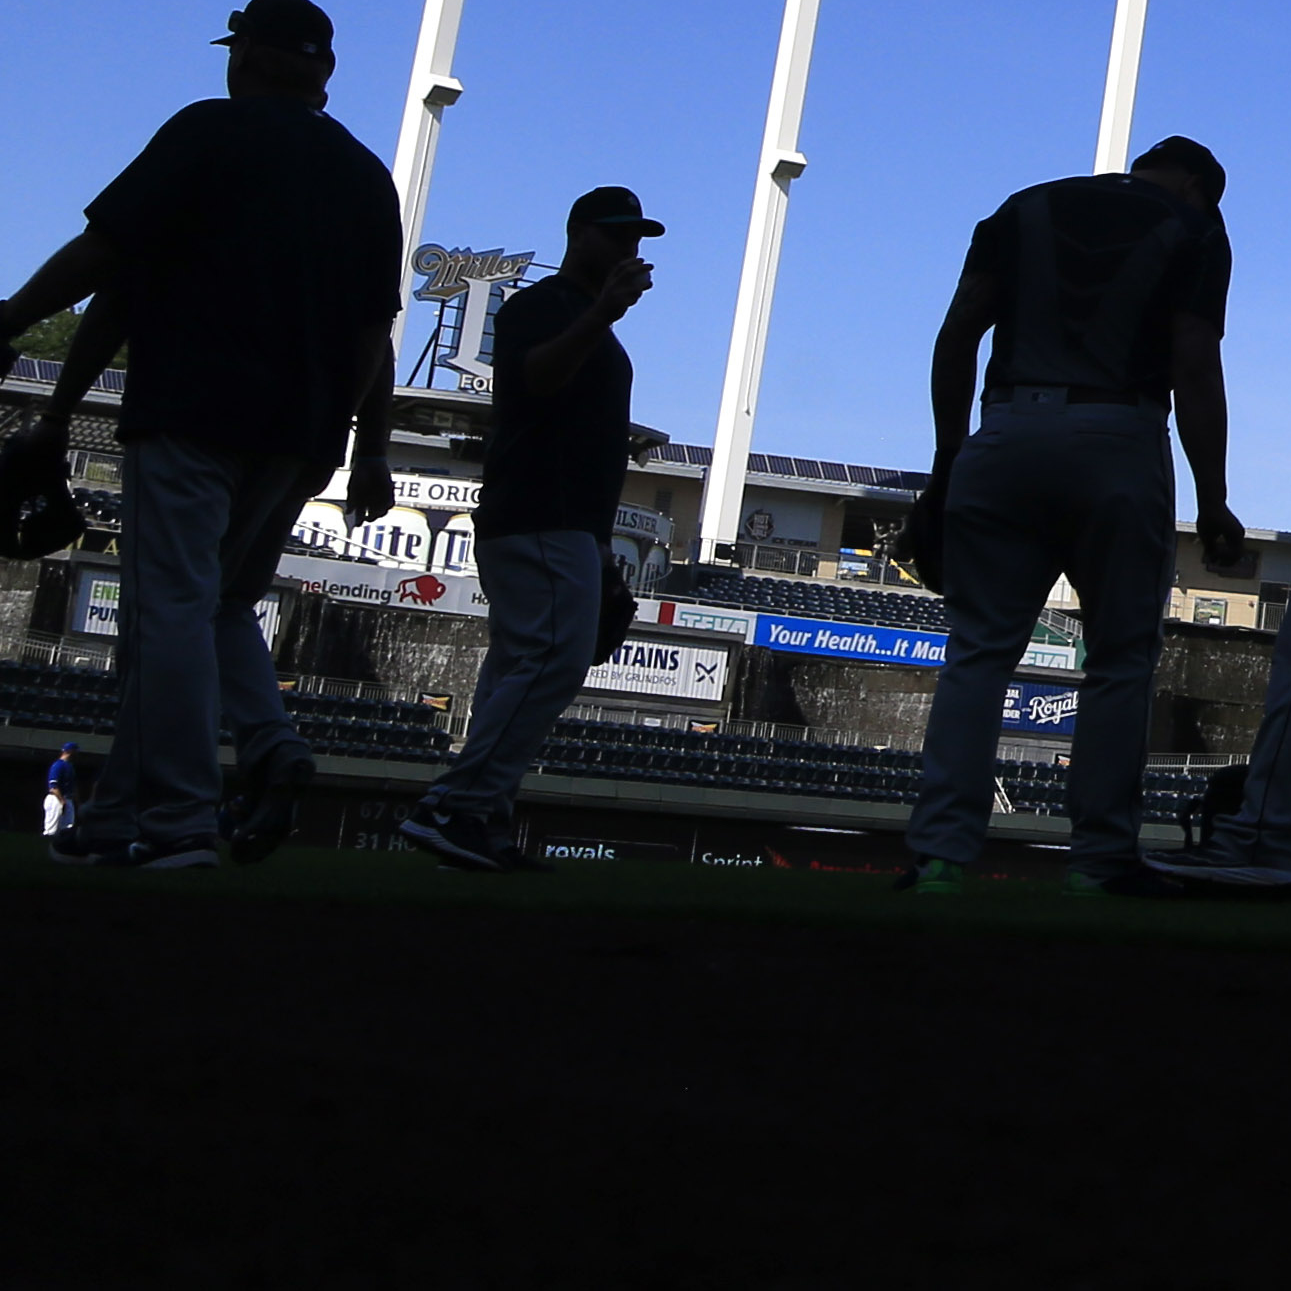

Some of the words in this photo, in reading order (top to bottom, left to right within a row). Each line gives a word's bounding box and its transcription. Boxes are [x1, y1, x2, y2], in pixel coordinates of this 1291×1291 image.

[411, 250, 529, 299] Miller
[276, 571, 393, 604] meLending
[768, 624, 813, 649] Your
[611, 670, 625, 680] BY
[625, 671, 677, 686] GRUNDFOS
